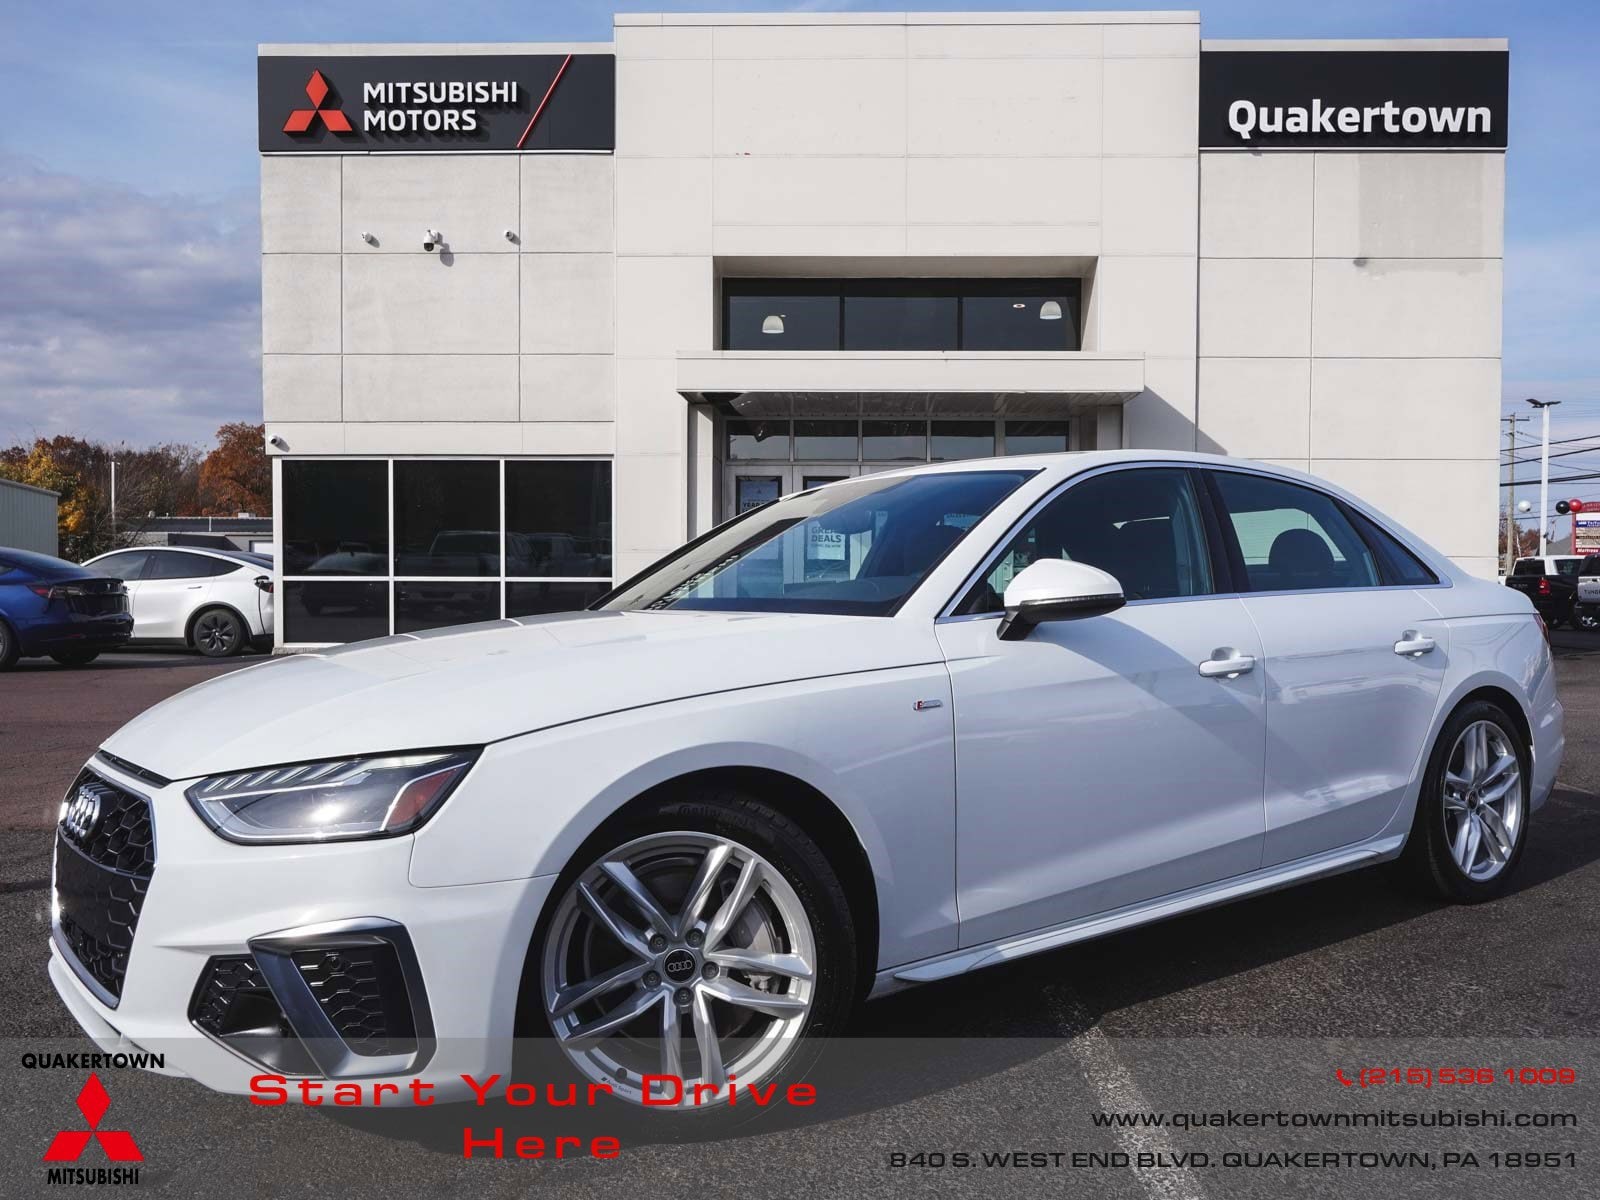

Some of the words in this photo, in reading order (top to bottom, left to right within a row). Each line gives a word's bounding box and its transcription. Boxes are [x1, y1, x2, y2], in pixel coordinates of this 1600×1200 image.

[363, 81, 517, 104] MITSUBISHI
[363, 109, 477, 131] MOTORS
[1228, 98, 1491, 140] Quakertown
[811, 534, 842, 543] DEALS
